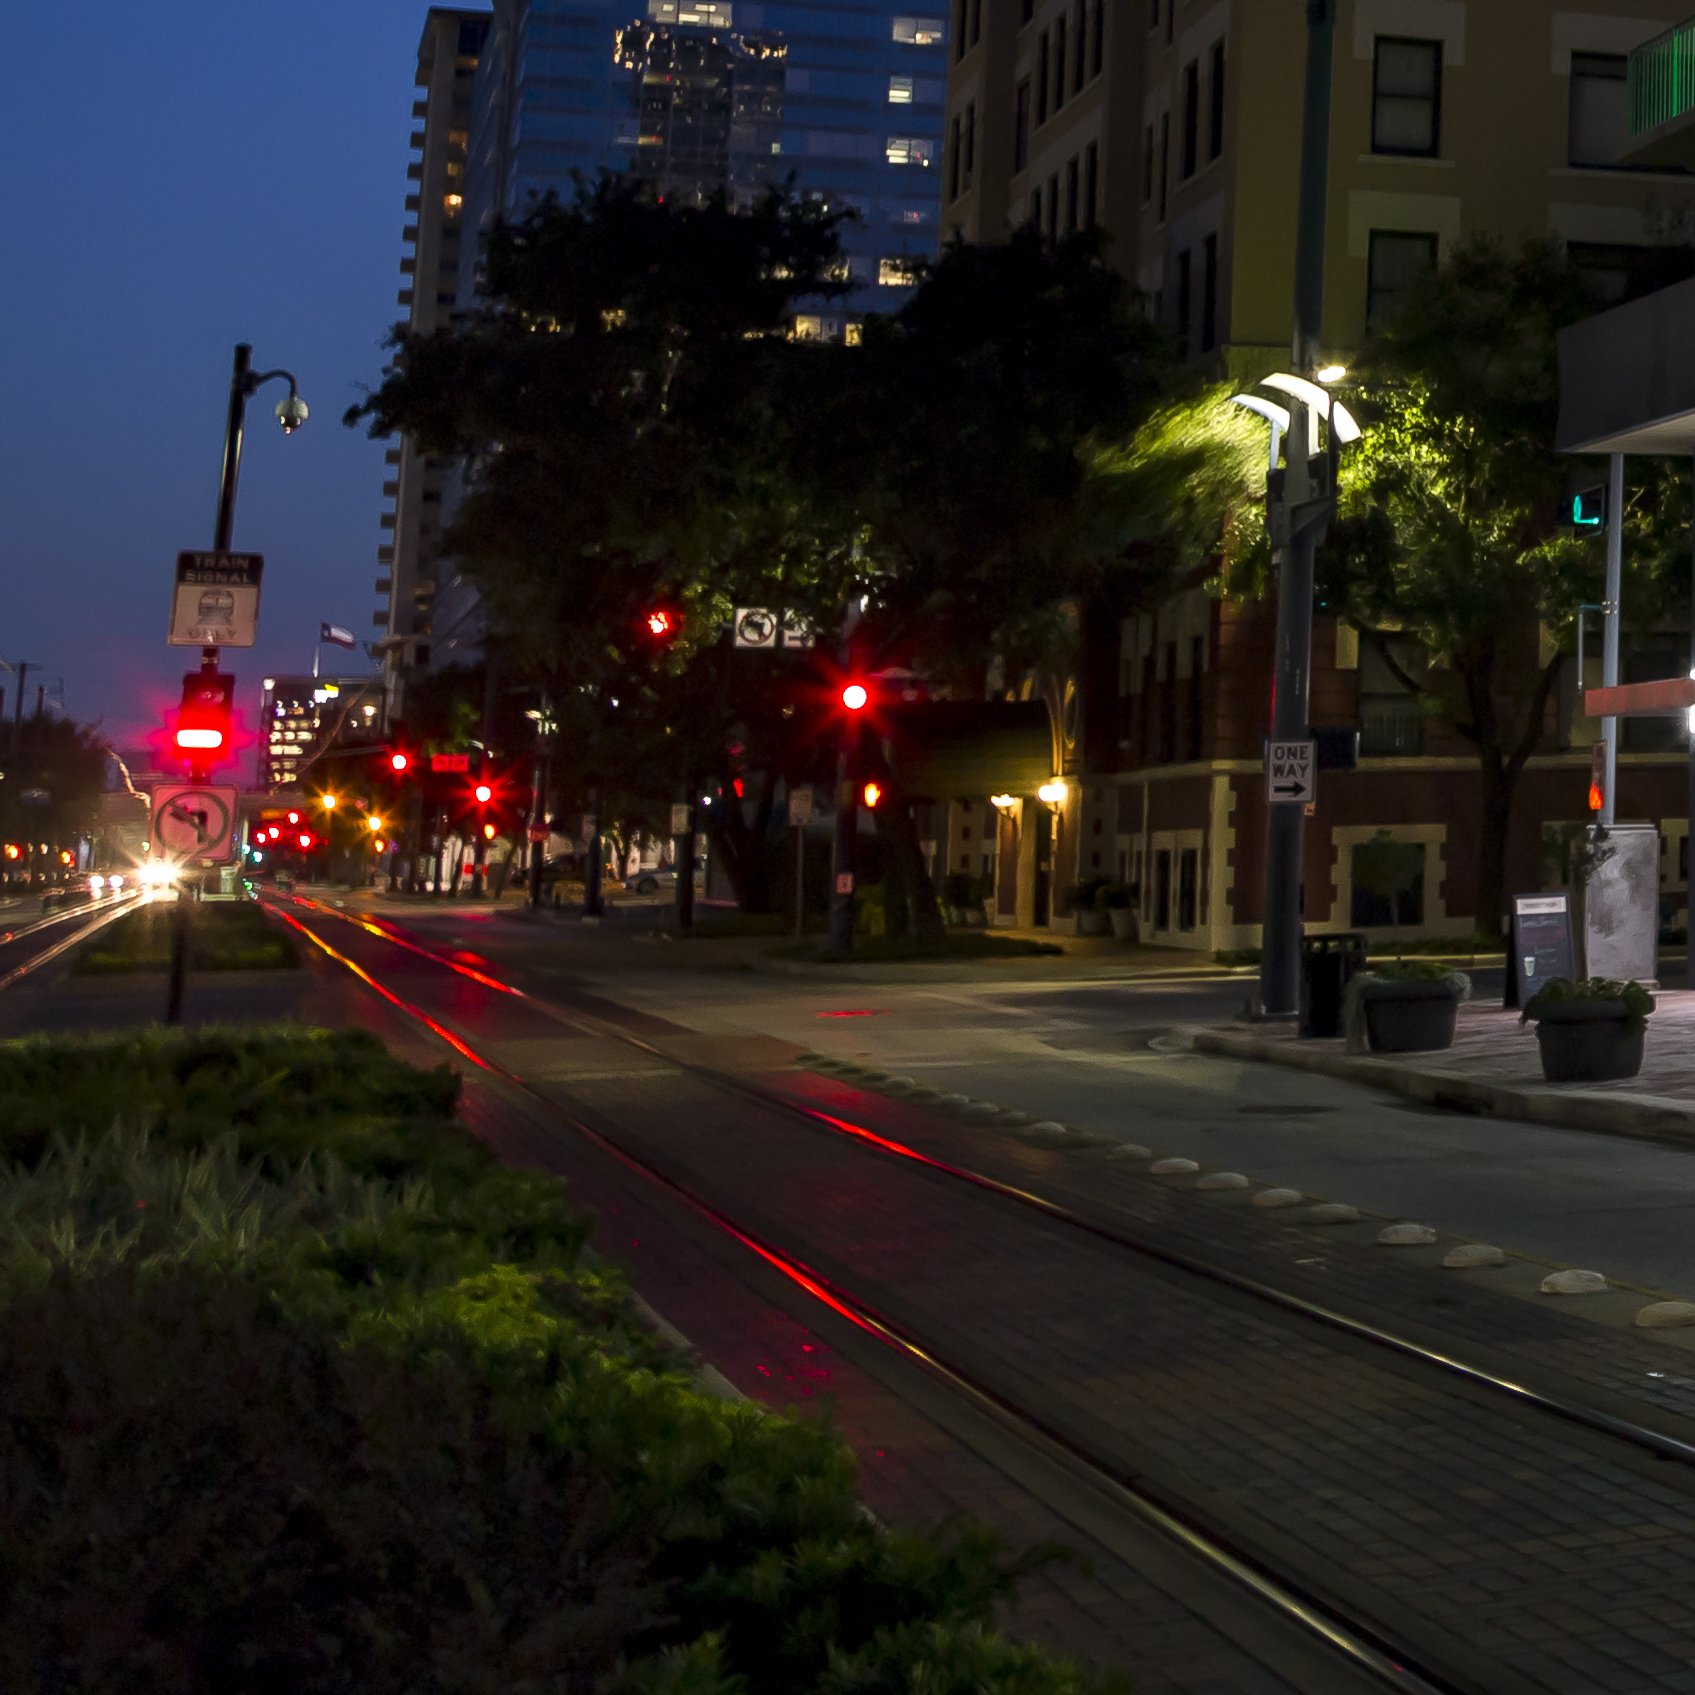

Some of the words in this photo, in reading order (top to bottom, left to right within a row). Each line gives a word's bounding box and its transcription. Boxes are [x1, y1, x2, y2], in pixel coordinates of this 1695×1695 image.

[194, 555, 250, 570] TRAIN
[185, 570, 251, 583] SIGNAL
[1274, 745, 1309, 761] ONE
[1272, 764, 1309, 778] WAY
